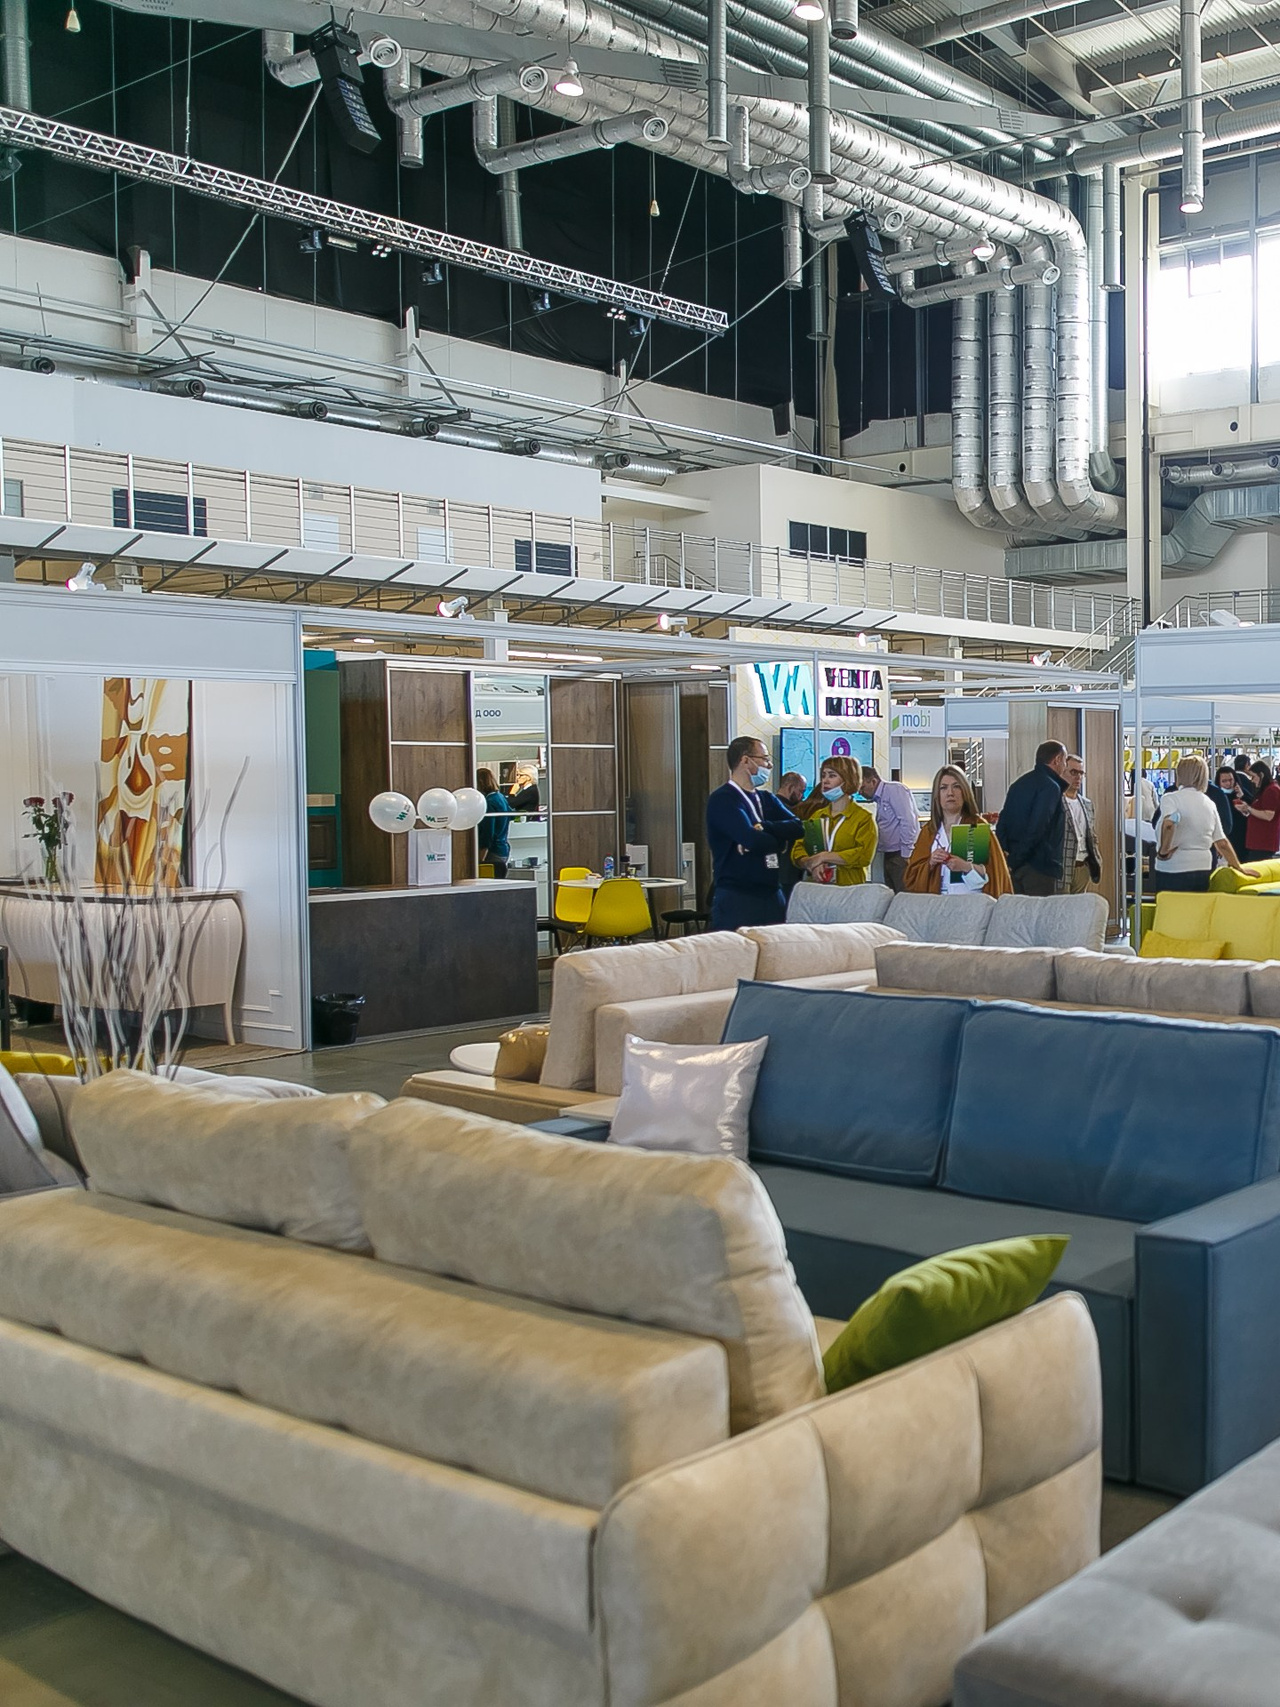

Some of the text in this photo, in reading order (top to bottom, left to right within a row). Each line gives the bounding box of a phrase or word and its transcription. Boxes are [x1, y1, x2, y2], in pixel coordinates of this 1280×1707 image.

[824, 667, 883, 690] VENTA
[825, 696, 883, 718] MEBEL
[902, 709, 931, 728] mobi
